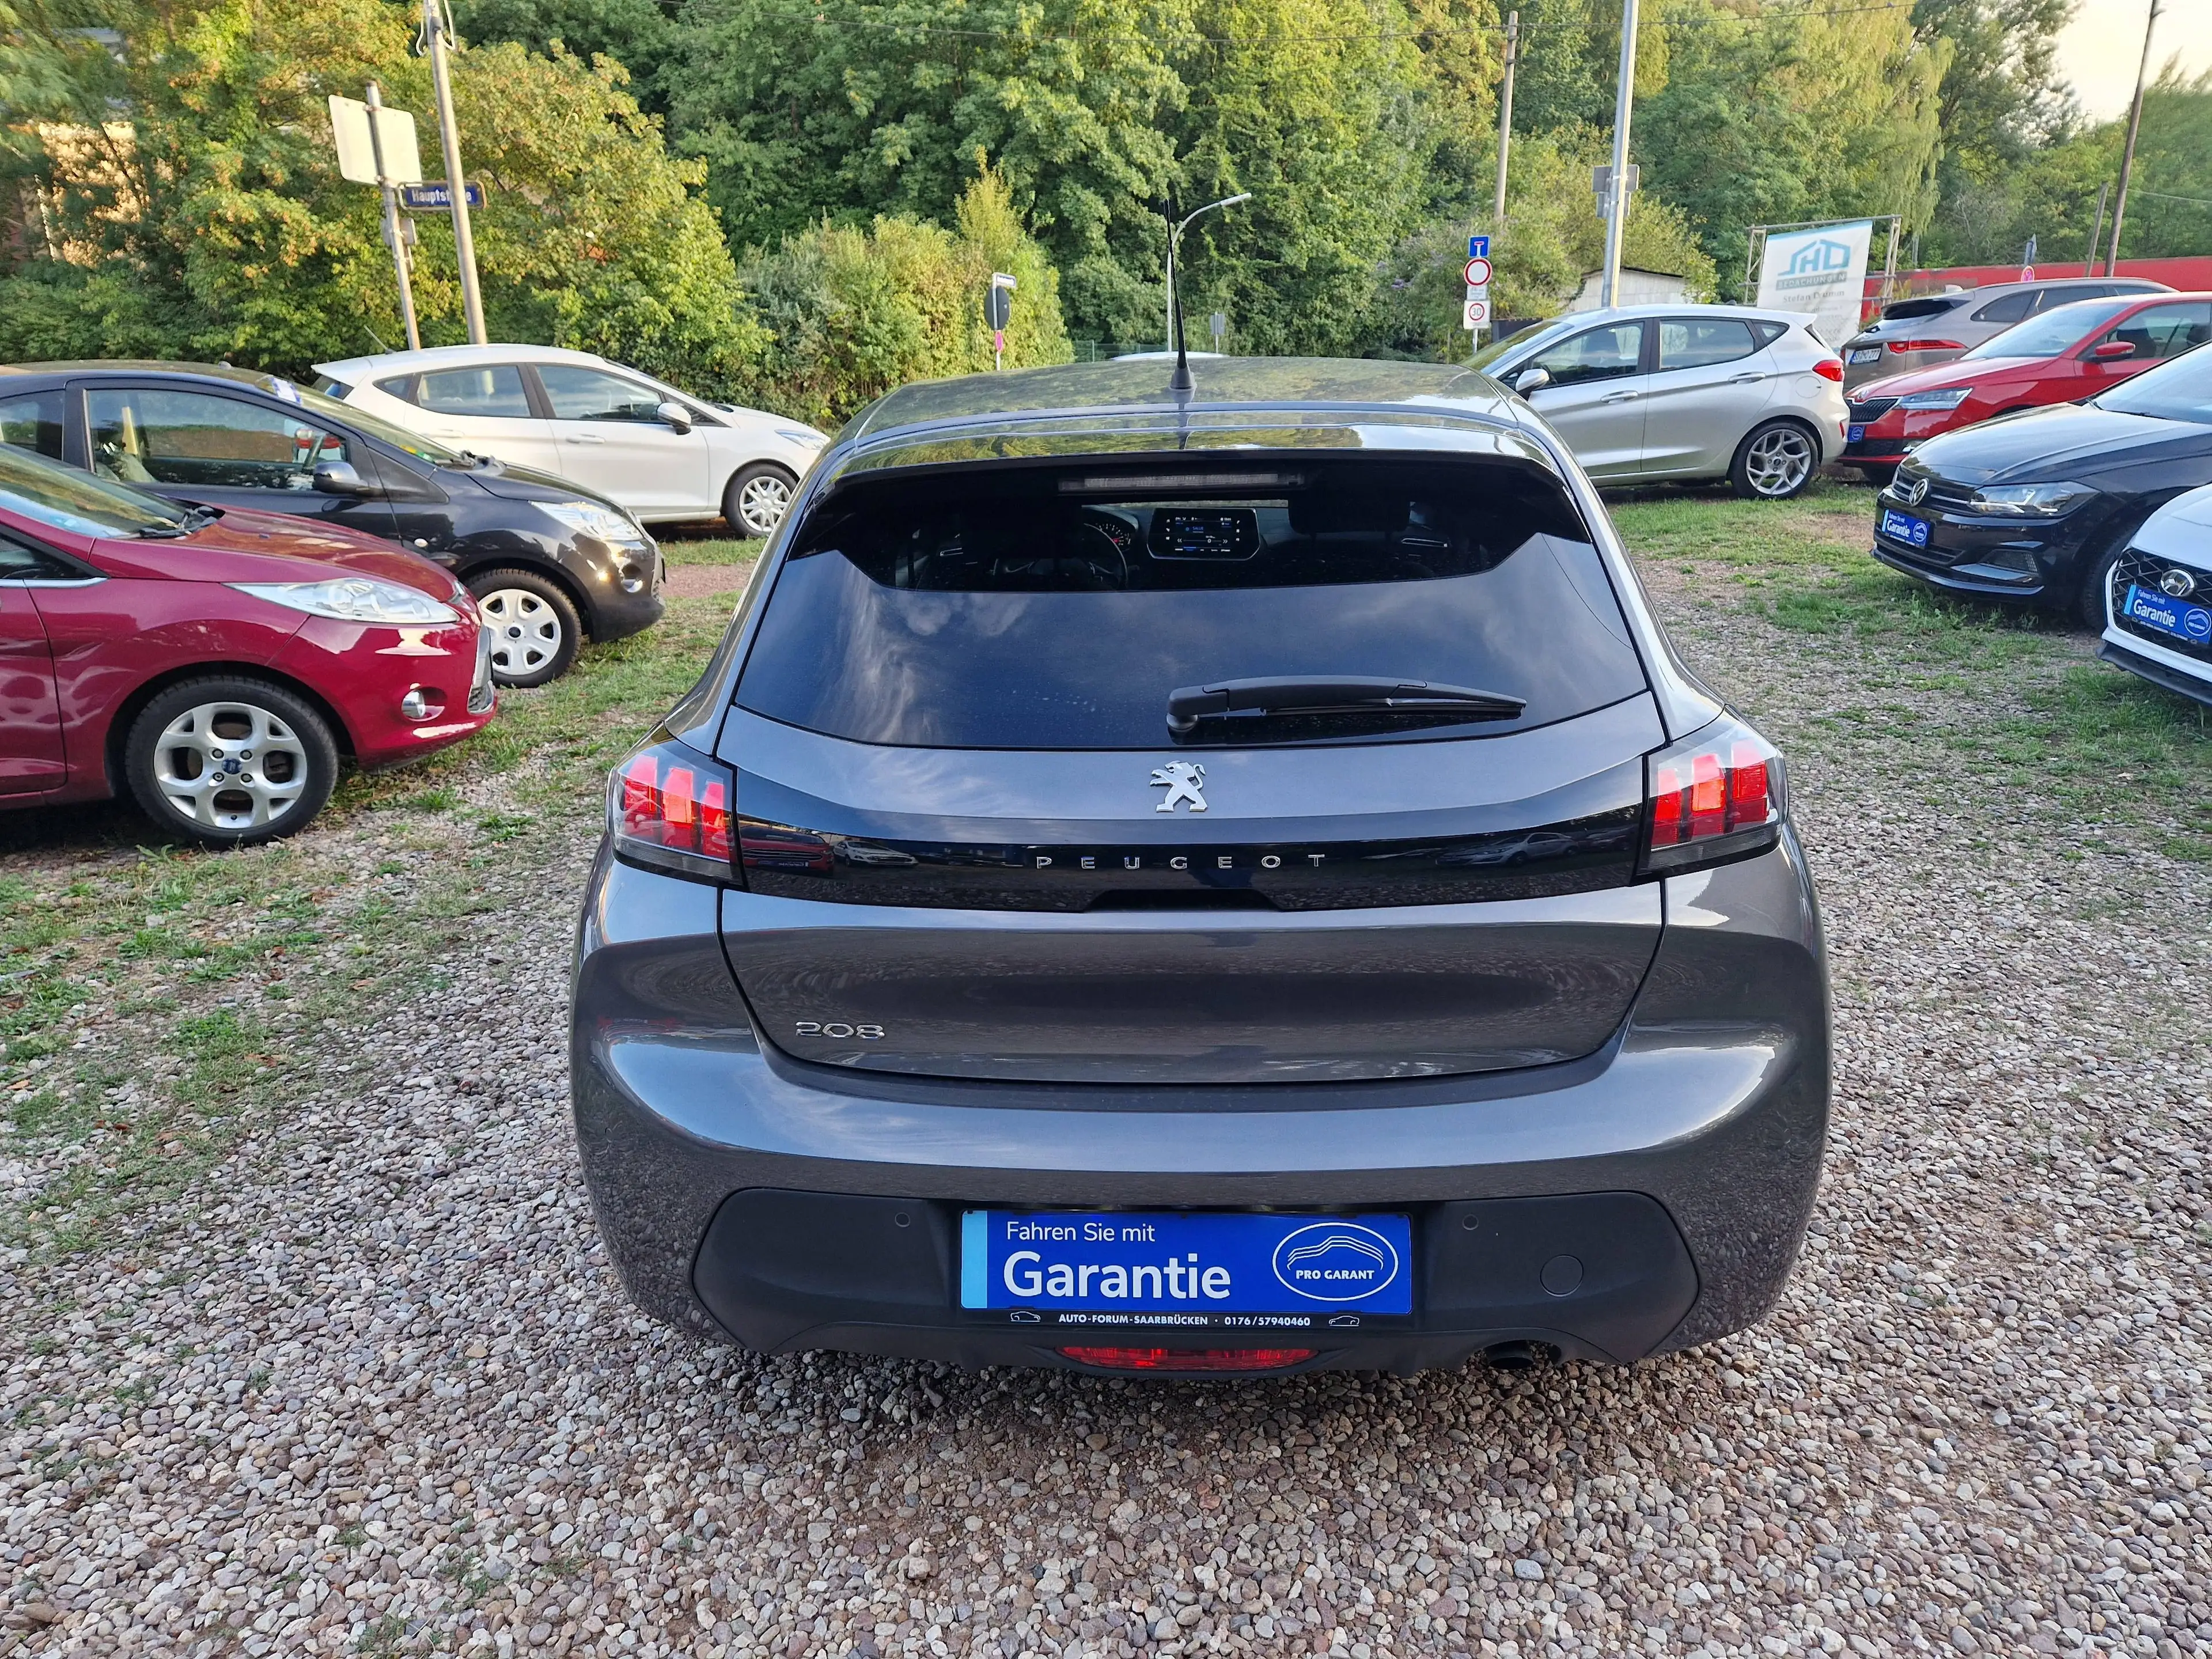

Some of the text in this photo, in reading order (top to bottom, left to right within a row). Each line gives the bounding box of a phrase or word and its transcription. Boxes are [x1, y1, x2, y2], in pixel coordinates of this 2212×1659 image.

[411, 188, 472, 204] Hauptste
[1472, 308, 1482, 316] 30
[1887, 520, 1910, 537] Garantie
[2134, 599, 2176, 627] Garantie
[1036, 853, 1326, 870] PEUGEOT
[796, 1021, 885, 1040] 208
[1006, 1221, 1156, 1243] Fahren Sie mit
[1003, 1251, 1232, 1300] Garantie
[1296, 1269, 1376, 1281] PRO GARANT
[1058, 1312, 1311, 1327] AUTO-FORUM-SAARBRÜCKEN 0176/57940460
